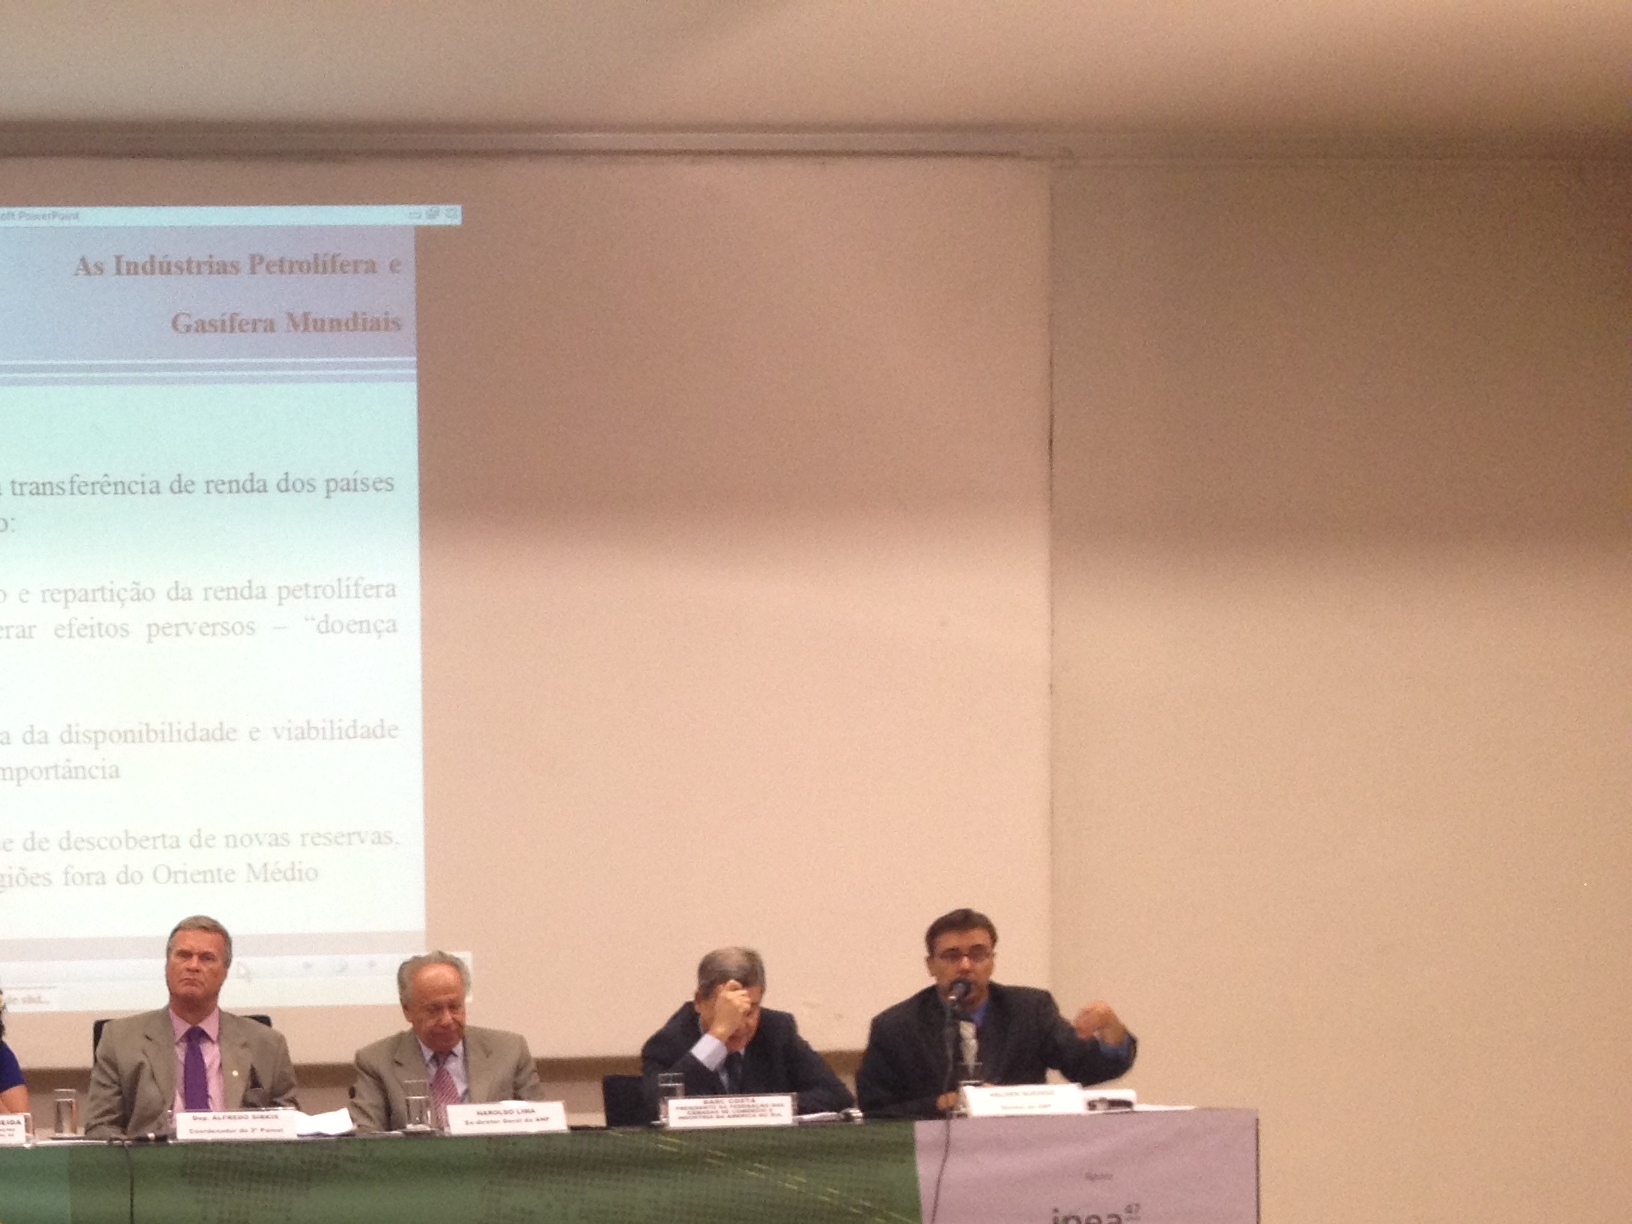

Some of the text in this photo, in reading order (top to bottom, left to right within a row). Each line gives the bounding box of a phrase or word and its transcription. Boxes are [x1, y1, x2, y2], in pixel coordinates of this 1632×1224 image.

[74, 253, 401, 277] As Indústrias Petrolífera e
[171, 311, 402, 334] Gasífera Mundiais
[10, 474, 162, 496] transferência
[169, 473, 196, 495] de
[205, 472, 268, 495] renda
[276, 472, 316, 494] dos
[325, 470, 395, 500] países
[19, 588, 30, 603] e
[41, 580, 156, 609] repartição
[166, 580, 193, 602] da
[203, 579, 267, 601] renda
[277, 576, 397, 606] petrolífera
[54, 617, 130, 639] efeitos
[146, 621, 256, 644] perversos
[22, 724, 50, 745] da
[59, 721, 237, 750] disponibilidade
[249, 727, 261, 742] e
[272, 718, 399, 741] viabilidade
[22, 831, 50, 853] de
[58, 829, 181, 852] descoberta
[189, 828, 216, 850] de
[224, 832, 291, 849] novas
[63, 865, 107, 887] fora
[115, 865, 144, 886] do
[152, 864, 236, 885] Oriente
[246, 860, 319, 883] Médio
